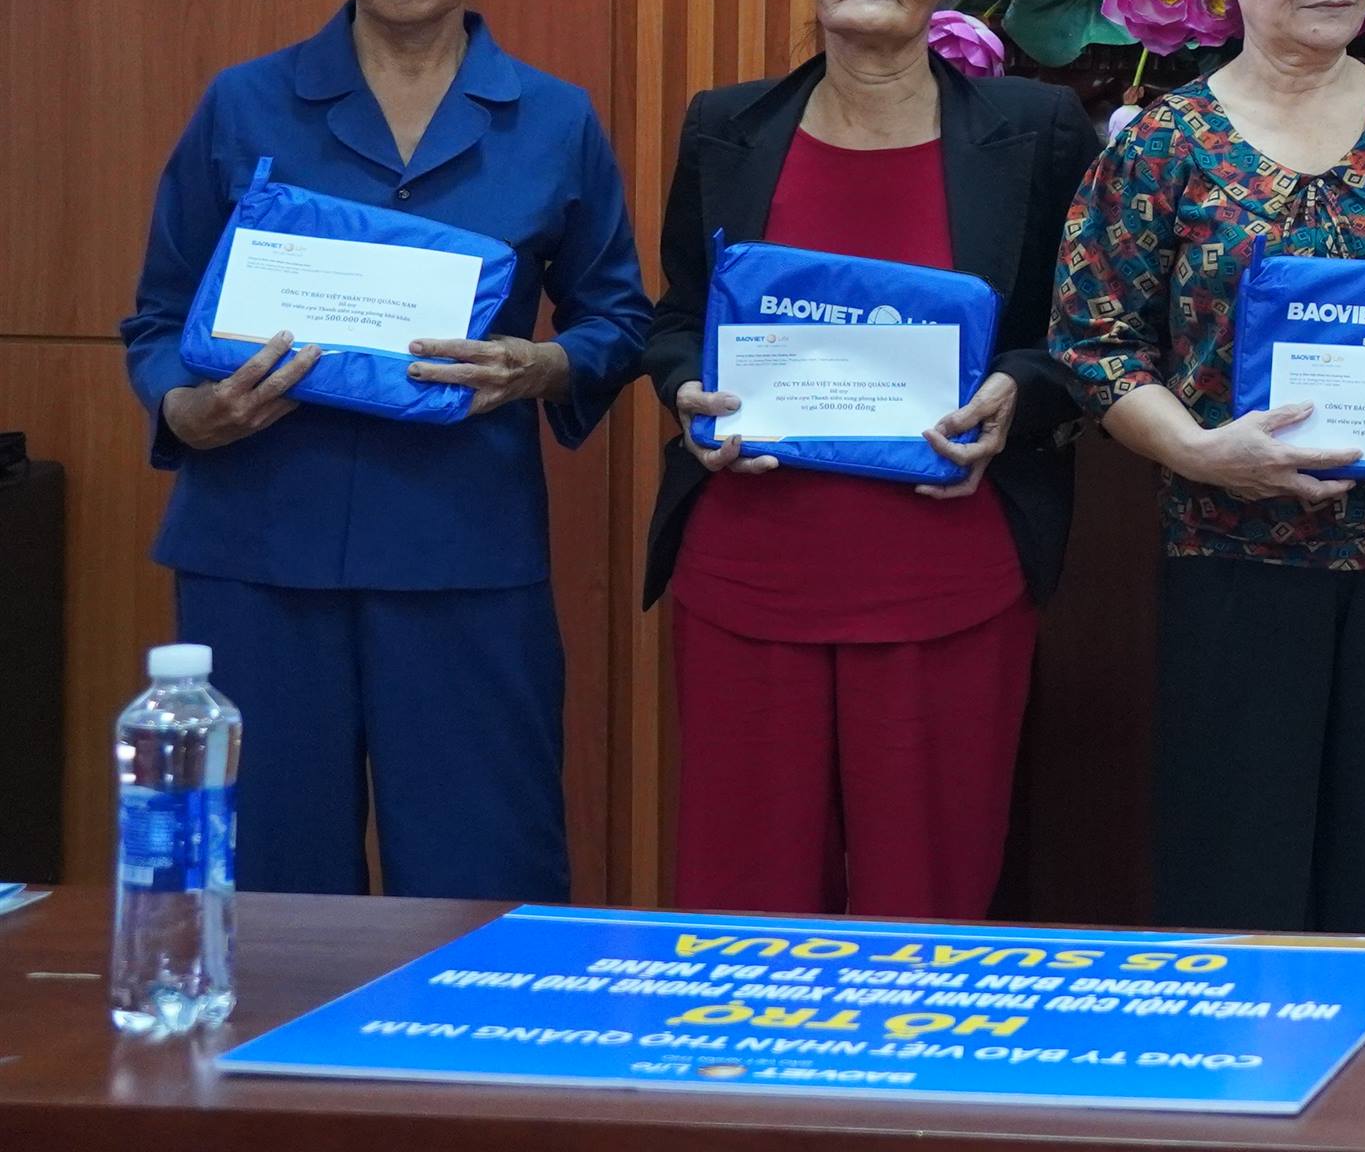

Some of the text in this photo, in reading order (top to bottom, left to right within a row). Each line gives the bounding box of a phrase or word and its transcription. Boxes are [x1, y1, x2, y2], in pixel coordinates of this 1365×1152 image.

[760, 295, 864, 325] BAOVIET
[676, 934, 1228, 972] 05 SUẤT QUÀ
[712, 964, 770, 980] ĐÀ
[772, 966, 822, 982] TP
[840, 965, 969, 988] THẠCH,
[431, 969, 1340, 1020] HỘI VIÊN HỘI CỰU THANH NIÊN XUNG PHONG KHÓ KHĂN
[979, 975, 1064, 993] BÀN
[1069, 977, 1235, 998] PHƯỜNG
[667, 1000, 1027, 1040] HỖ TRỢ
[362, 1021, 1263, 1068] CÔNG TY BẢO VIỆT NHÂN THỌ QUẢNG NAM
[631, 1061, 917, 1084] BAOVIET Life
